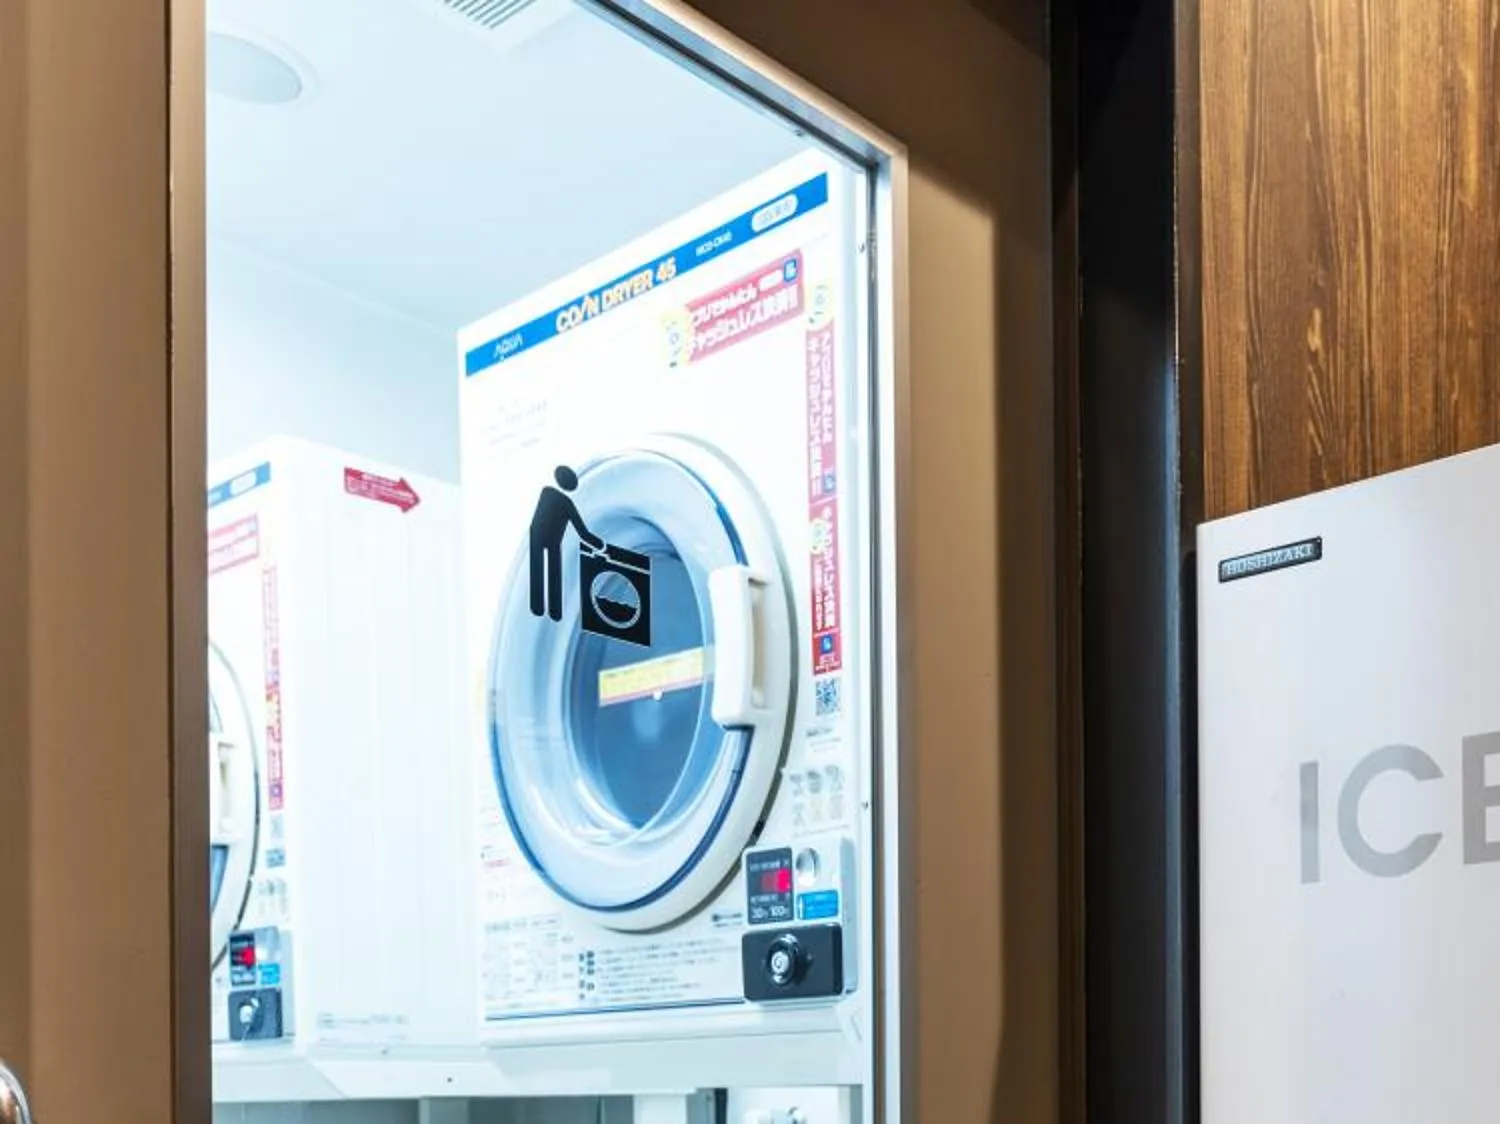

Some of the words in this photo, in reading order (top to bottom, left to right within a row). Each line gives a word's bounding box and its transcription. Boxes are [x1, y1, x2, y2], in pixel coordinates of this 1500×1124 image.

[603, 270, 653, 311] DRYER
[656, 256, 677, 284] 45
[1226, 542, 1314, 575] HOSHIZAKI
